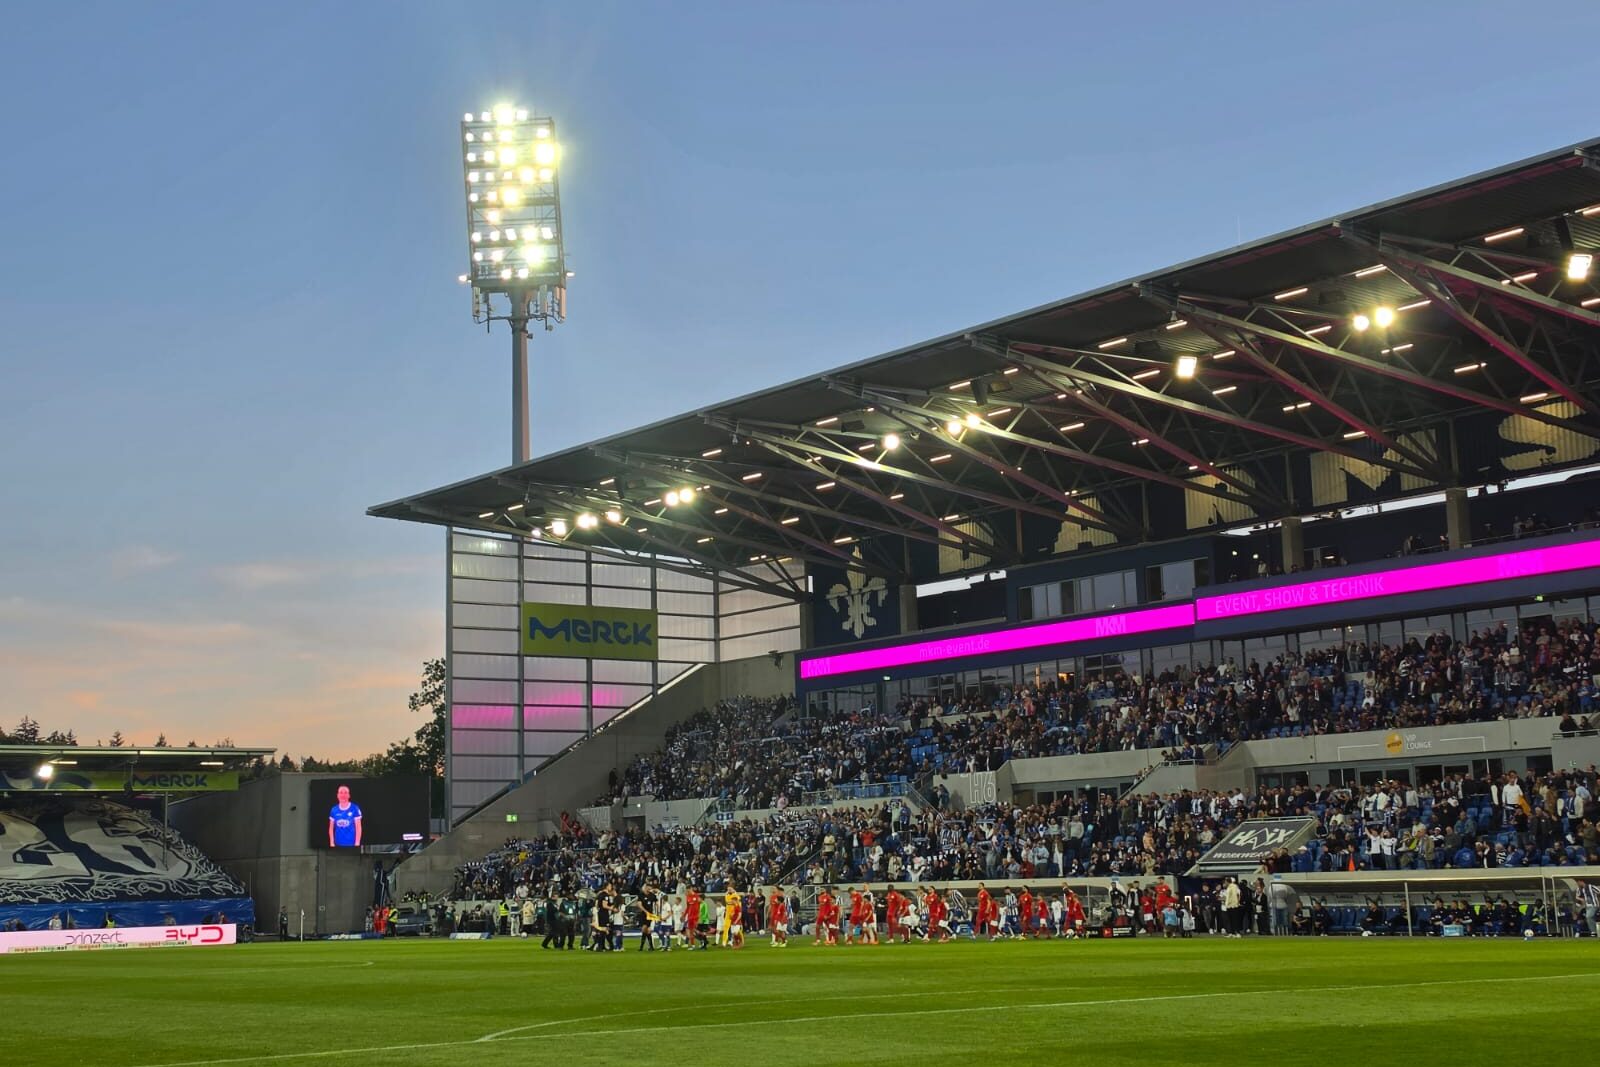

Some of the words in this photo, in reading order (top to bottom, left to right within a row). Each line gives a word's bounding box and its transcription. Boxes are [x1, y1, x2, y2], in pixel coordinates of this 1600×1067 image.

[1215, 594, 1261, 614] EVENT,
[1264, 588, 1304, 607] SHOW
[1309, 586, 1318, 600] &
[1323, 576, 1384, 599] TECHNIK
[529, 616, 652, 646] MERCK
[1406, 740, 1432, 750] LOUNGE
[132, 773, 208, 787] MERCK
